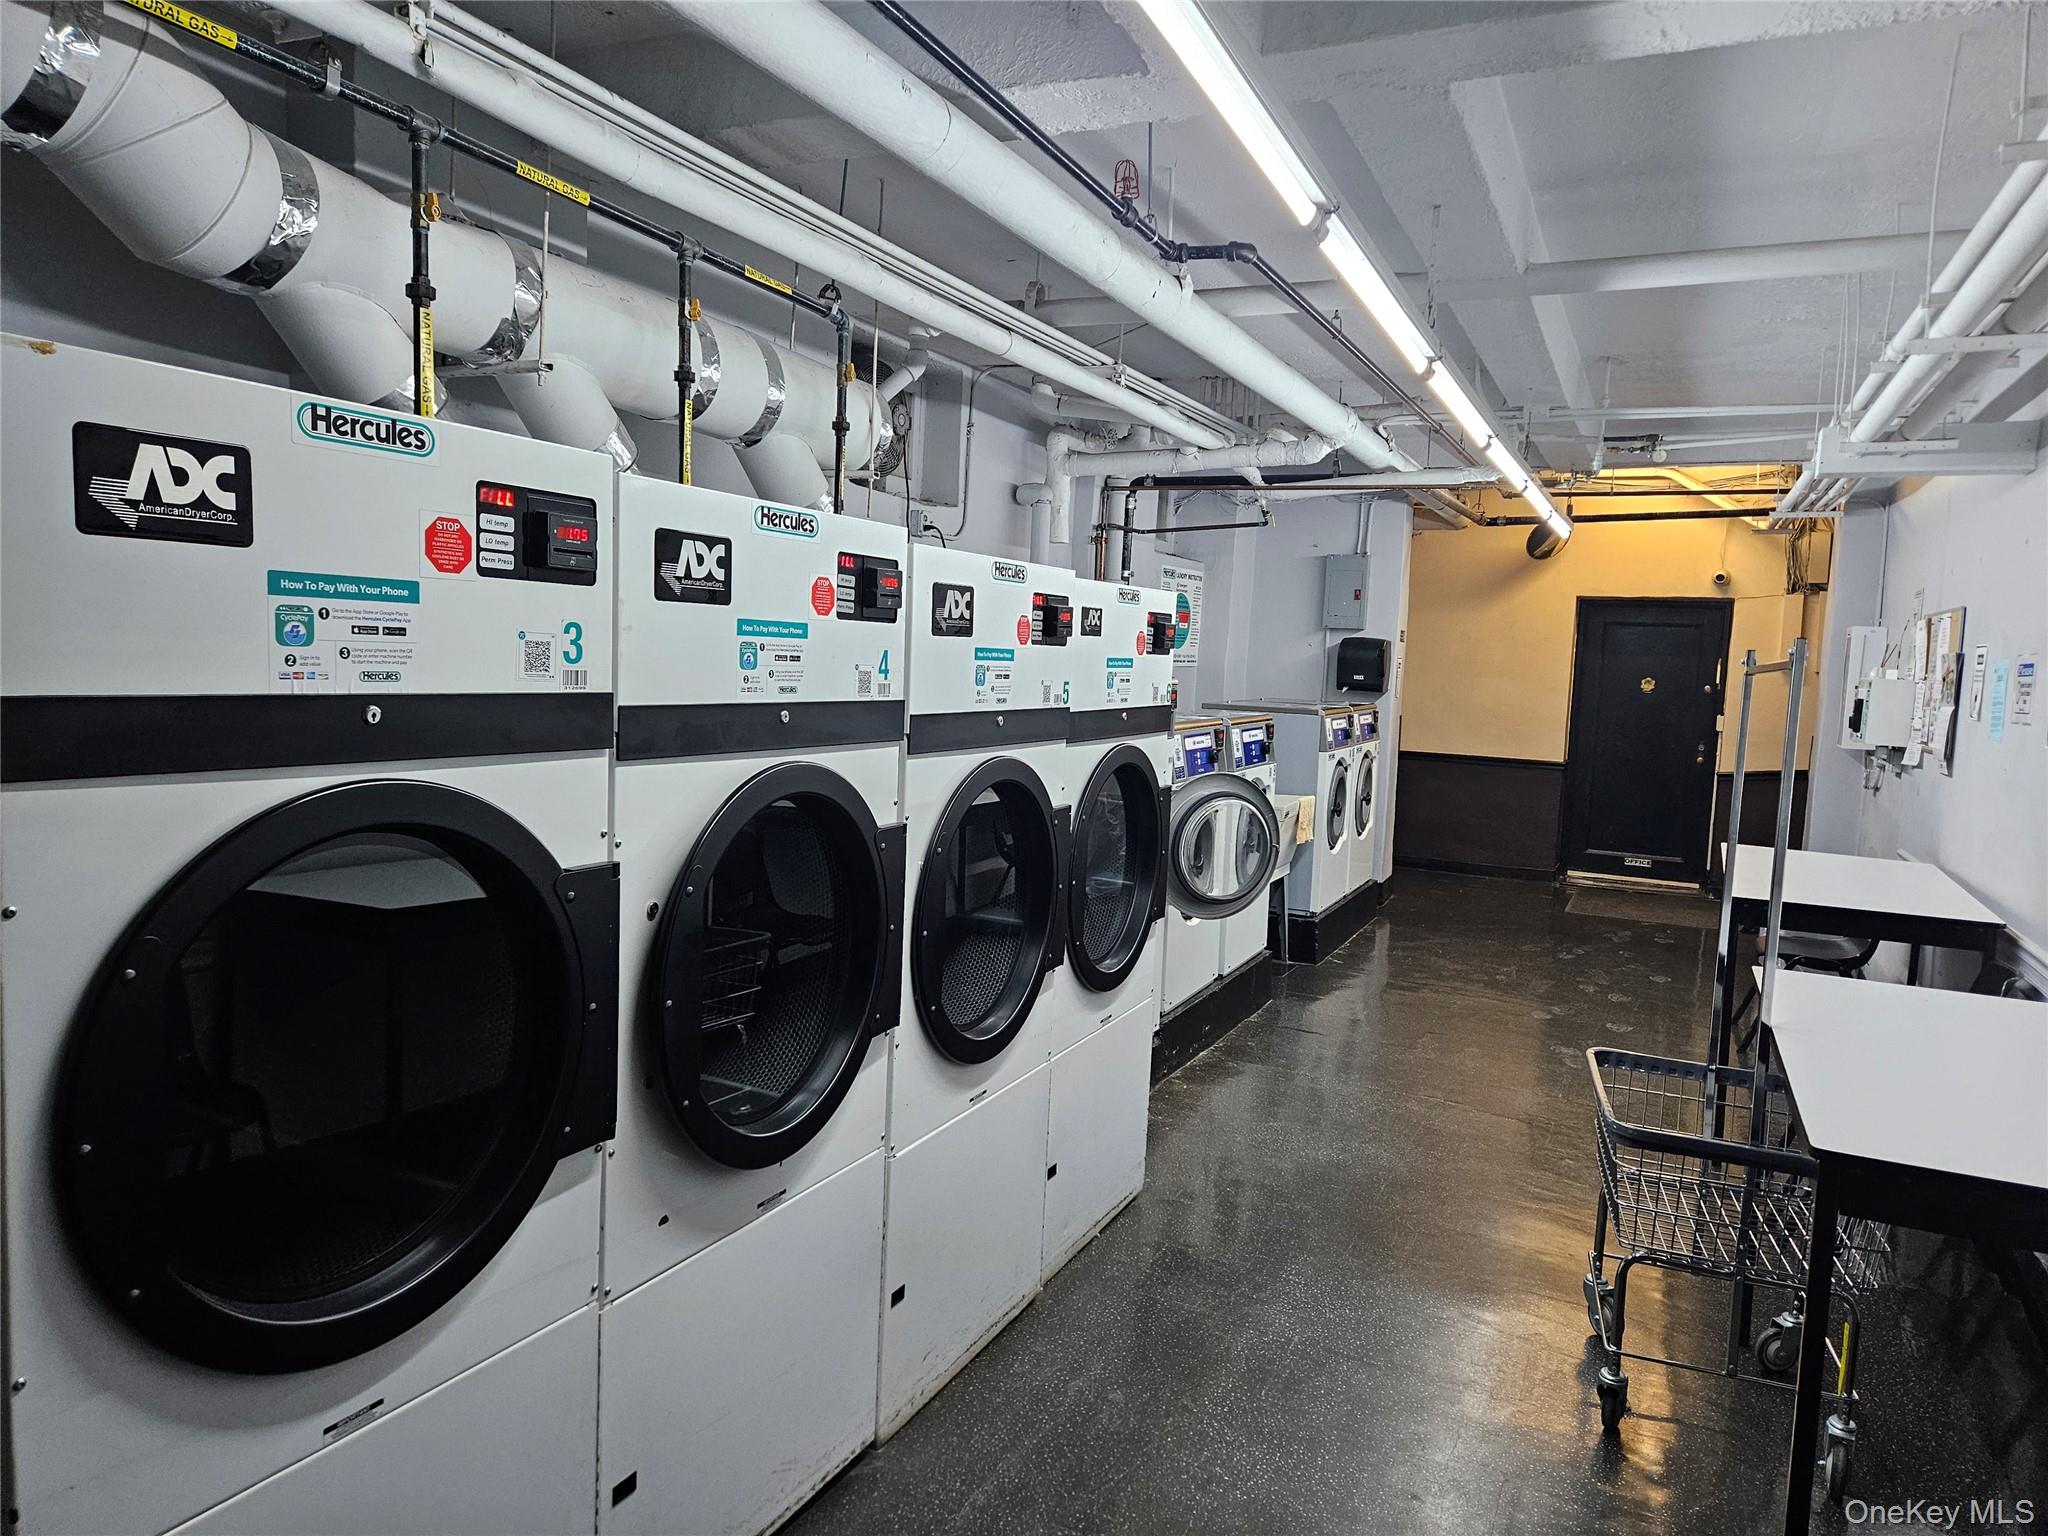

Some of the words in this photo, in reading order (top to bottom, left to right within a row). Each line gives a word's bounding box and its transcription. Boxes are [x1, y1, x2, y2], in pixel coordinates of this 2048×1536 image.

[131, 0, 184, 24] URAL
[189, 17, 219, 39] GAS
[519, 163, 559, 190] NATURAL
[562, 184, 579, 199] GAS
[422, 311, 431, 373] NATURAL
[422, 376, 432, 403] GAS
[311, 403, 426, 450] Hercules
[125, 443, 236, 511] ADC
[138, 502, 236, 522] AmericanDryerCorp.
[494, 520, 509, 528] temp
[761, 506, 815, 533] Hercules
[436, 521, 460, 531] STOP
[494, 539, 509, 547] temp
[481, 556, 496, 564] Perm
[497, 557, 513, 566] Press
[675, 539, 725, 580] ADC
[994, 562, 1025, 580] Hercules
[280, 579, 304, 589] How
[305, 581, 316, 590] To
[318, 582, 334, 594] Pay
[337, 583, 359, 593] With
[360, 585, 381, 594] Your
[382, 586, 409, 597] Phone
[1119, 588, 1140, 602] Hercules
[943, 589, 971, 619] ADC
[563, 622, 583, 665] 3
[362, 671, 399, 680] Hercules
[878, 649, 890, 680] 4
[1063, 681, 1070, 705] 5
[1624, 858, 1651, 866] OFFICE
